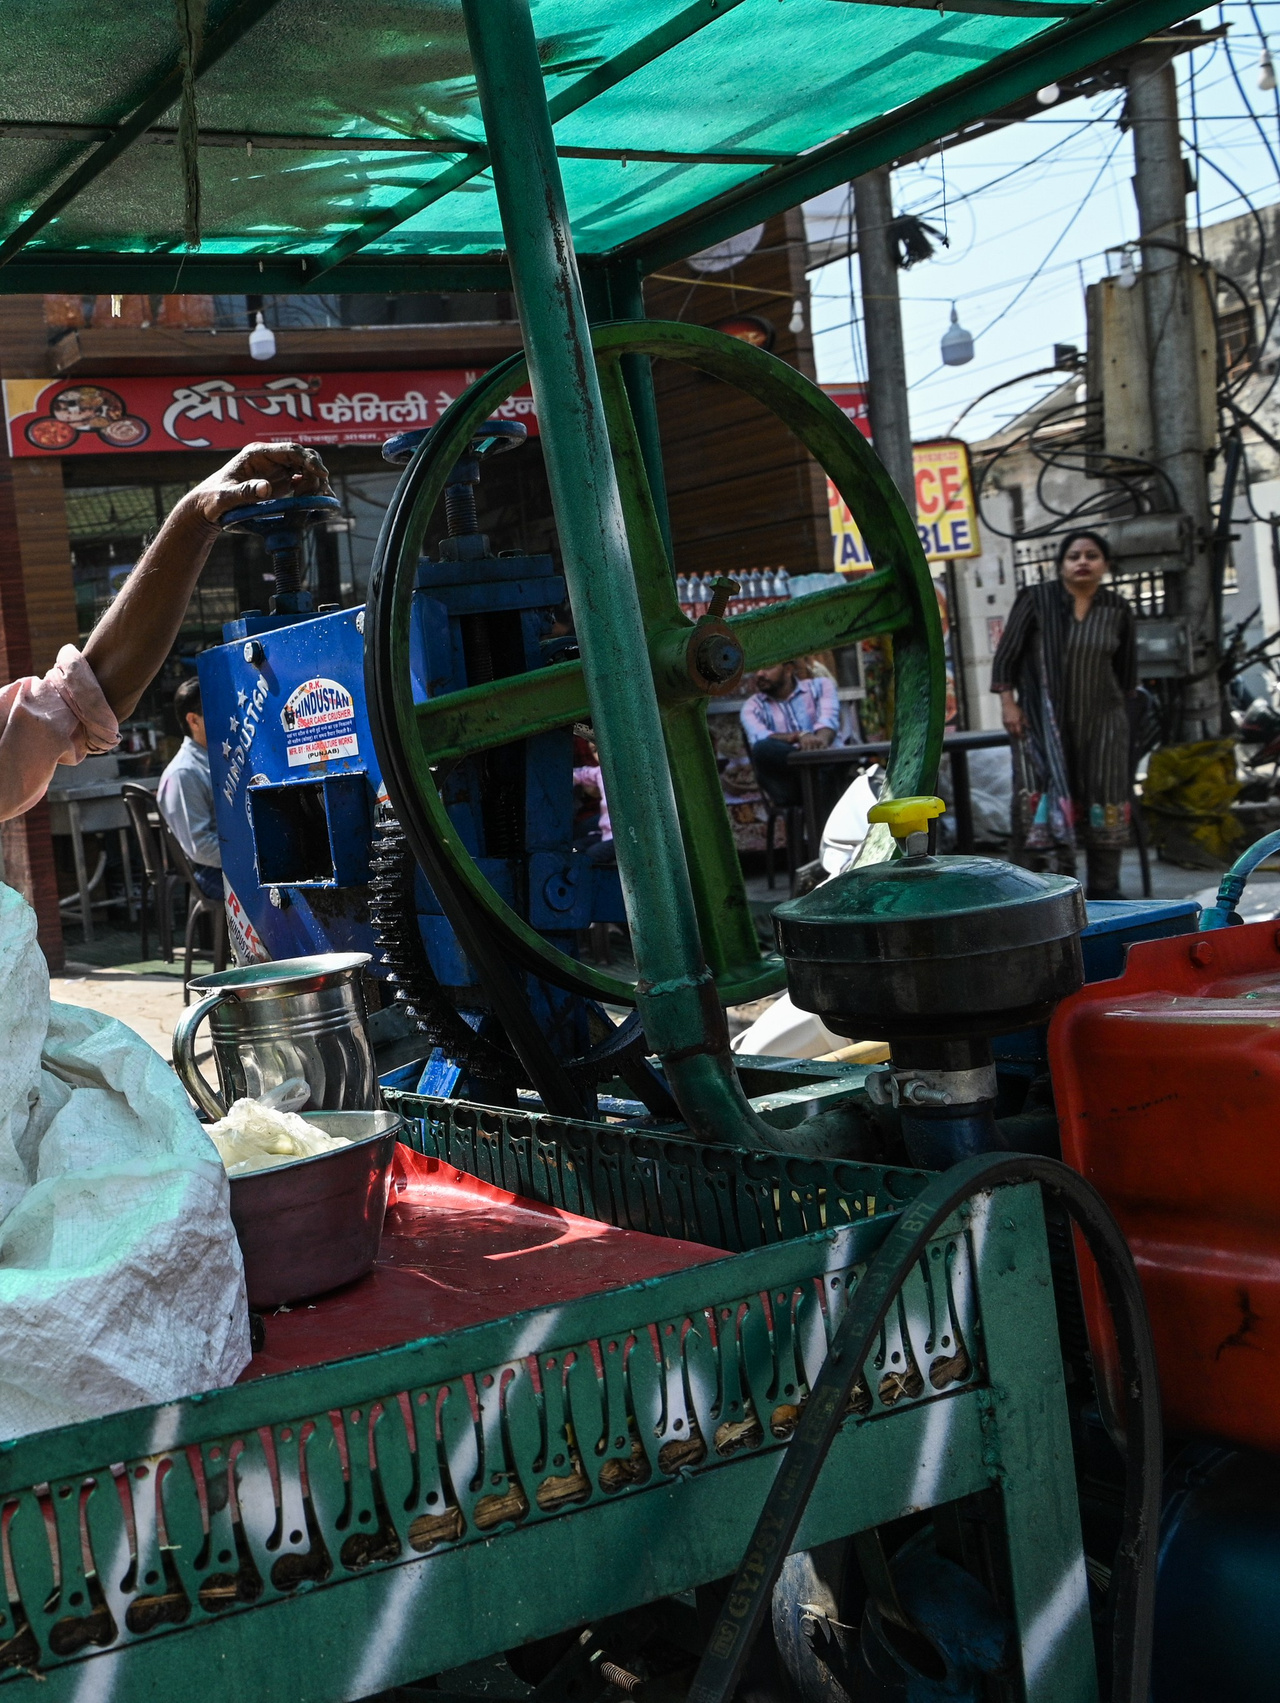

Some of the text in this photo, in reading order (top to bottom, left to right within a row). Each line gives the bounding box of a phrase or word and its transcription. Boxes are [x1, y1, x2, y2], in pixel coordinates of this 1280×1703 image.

[319, 391, 428, 423] फैमिली
[308, 680, 323, 690] R.K.
[295, 687, 350, 718] HINDUSTAN
[314, 714, 328, 724] CANE
[328, 709, 352, 722] CRUSHER
[223, 674, 269, 807] HINDUSTAN
[307, 747, 340, 759] (PUNJAB)
[727, 1511, 786, 1620] GYPSY
